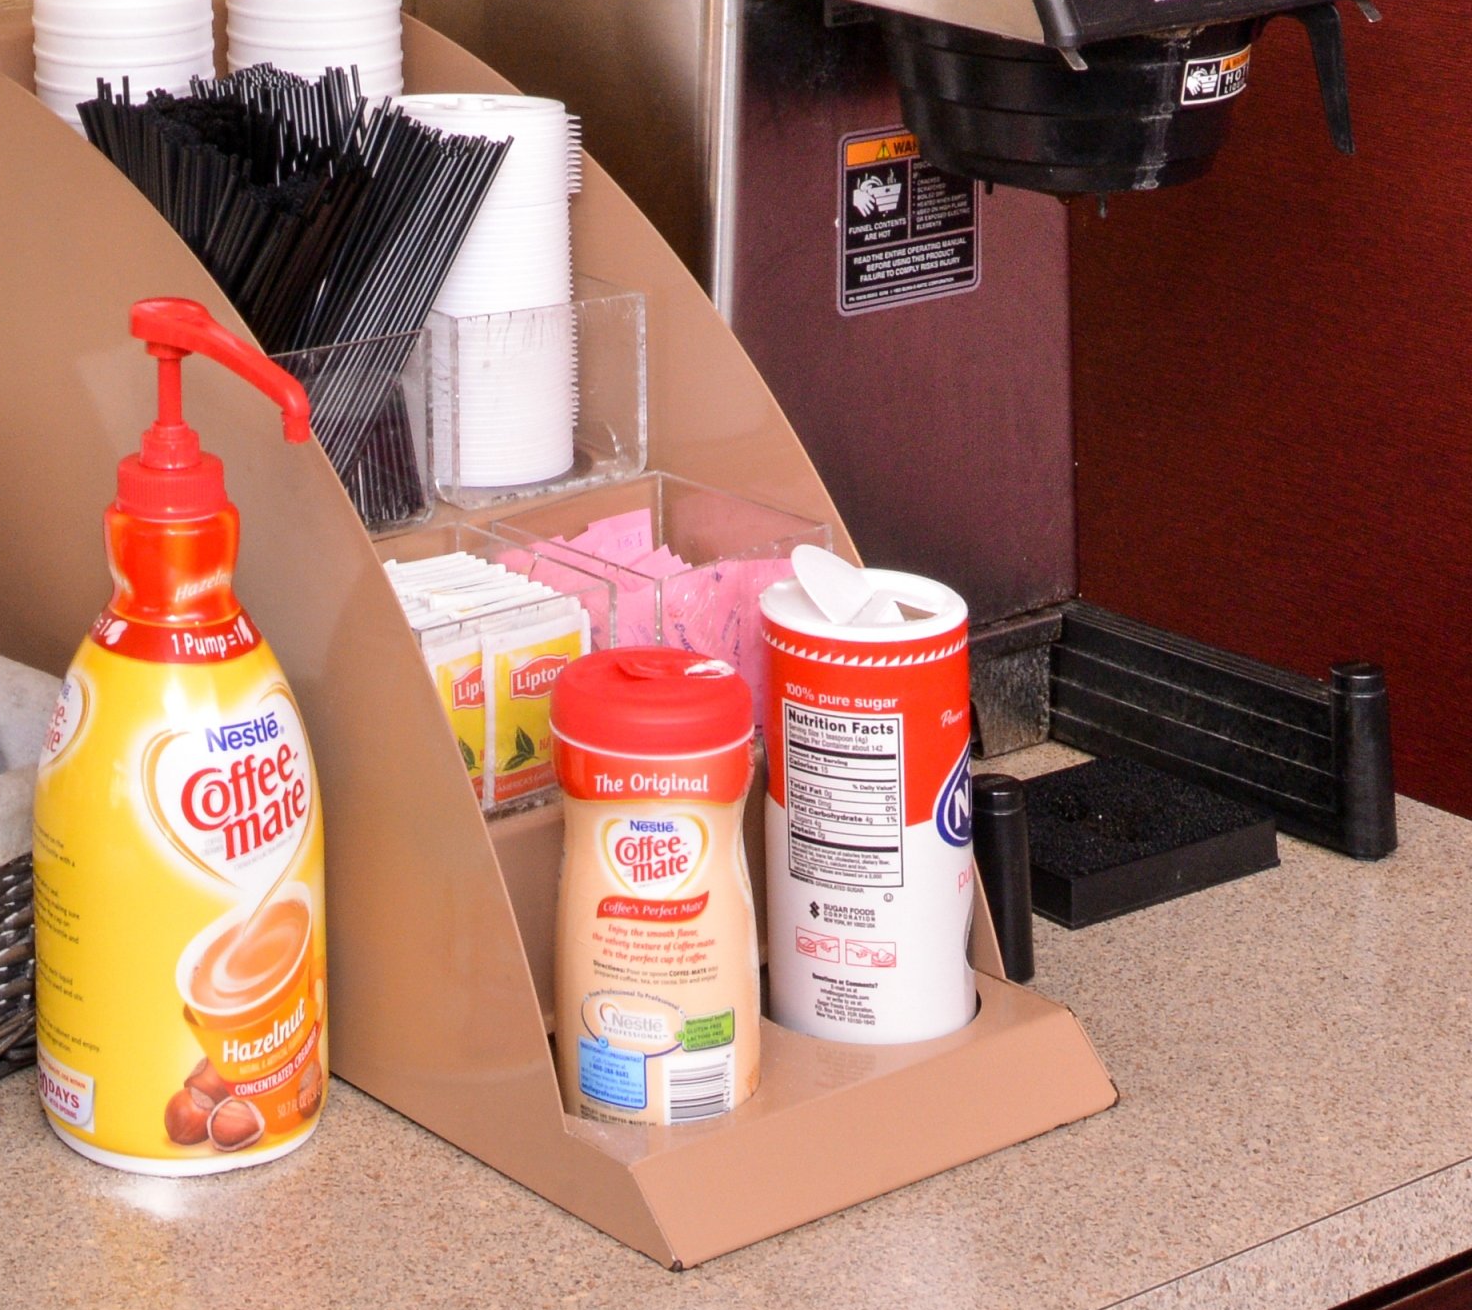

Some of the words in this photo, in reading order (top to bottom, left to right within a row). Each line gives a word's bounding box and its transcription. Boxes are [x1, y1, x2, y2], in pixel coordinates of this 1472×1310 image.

[849, 225, 873, 234] FUNNEL
[874, 217, 907, 230] CONTENTS
[865, 233, 877, 241] ARE
[878, 230, 891, 239] HOT
[854, 255, 871, 264] READ
[872, 253, 883, 261] THE
[885, 249, 906, 259] ENTIRE
[907, 243, 941, 256] OPERATING
[942, 237, 967, 248] MANUAL
[866, 260, 891, 272] BEFORE
[892, 256, 911, 267] USING
[912, 253, 925, 262] THIS
[926, 248, 954, 260] PRODUCT
[860, 271, 885, 282] FAILURE
[896, 264, 920, 276] COMPLY
[920, 260, 938, 270] RISKS
[183, 632, 227, 658] Pump
[786, 682, 815, 701] 100%
[818, 693, 850, 706] pure
[854, 698, 898, 711] sugar
[205, 712, 278, 753] Nestlé
[788, 709, 846, 733] Nutrition
[852, 722, 894, 735] Facts
[808, 729, 819, 737] Size
[811, 736, 820, 745] Per
[789, 757, 818, 771] Calories
[811, 752, 821, 761] Per
[181, 744, 298, 831] Coffee-
[594, 773, 624, 792] The
[630, 773, 709, 796] Original
[790, 780, 807, 791] Total
[809, 786, 822, 795] Fat
[790, 791, 816, 804] Sodium
[223, 779, 306, 861] mate
[790, 801, 807, 812] Total
[809, 807, 862, 822] Carbohydrate
[791, 823, 816, 836] Protein
[615, 835, 687, 866] Coffee-
[633, 854, 688, 882] mate
[603, 901, 639, 914] Coffee's
[642, 905, 678, 918] Perfect
[824, 904, 848, 913] SUGAR
[824, 911, 875, 921] CORPORATION
[608, 924, 628, 936] Enjoy
[631, 928, 643, 936] the
[647, 929, 675, 937] smooth
[592, 932, 603, 942] the
[605, 935, 630, 949] velvety
[632, 942, 661, 951] texture
[664, 942, 671, 952] of
[616, 950, 627, 959] the
[629, 953, 658, 964] perfect
[660, 956, 674, 965] cup
[676, 955, 685, 965] of
[223, 998, 306, 1063] Hazelnut
[235, 1063, 294, 1095] CONCENTRATED
[48, 1078, 80, 1109] DAYS
